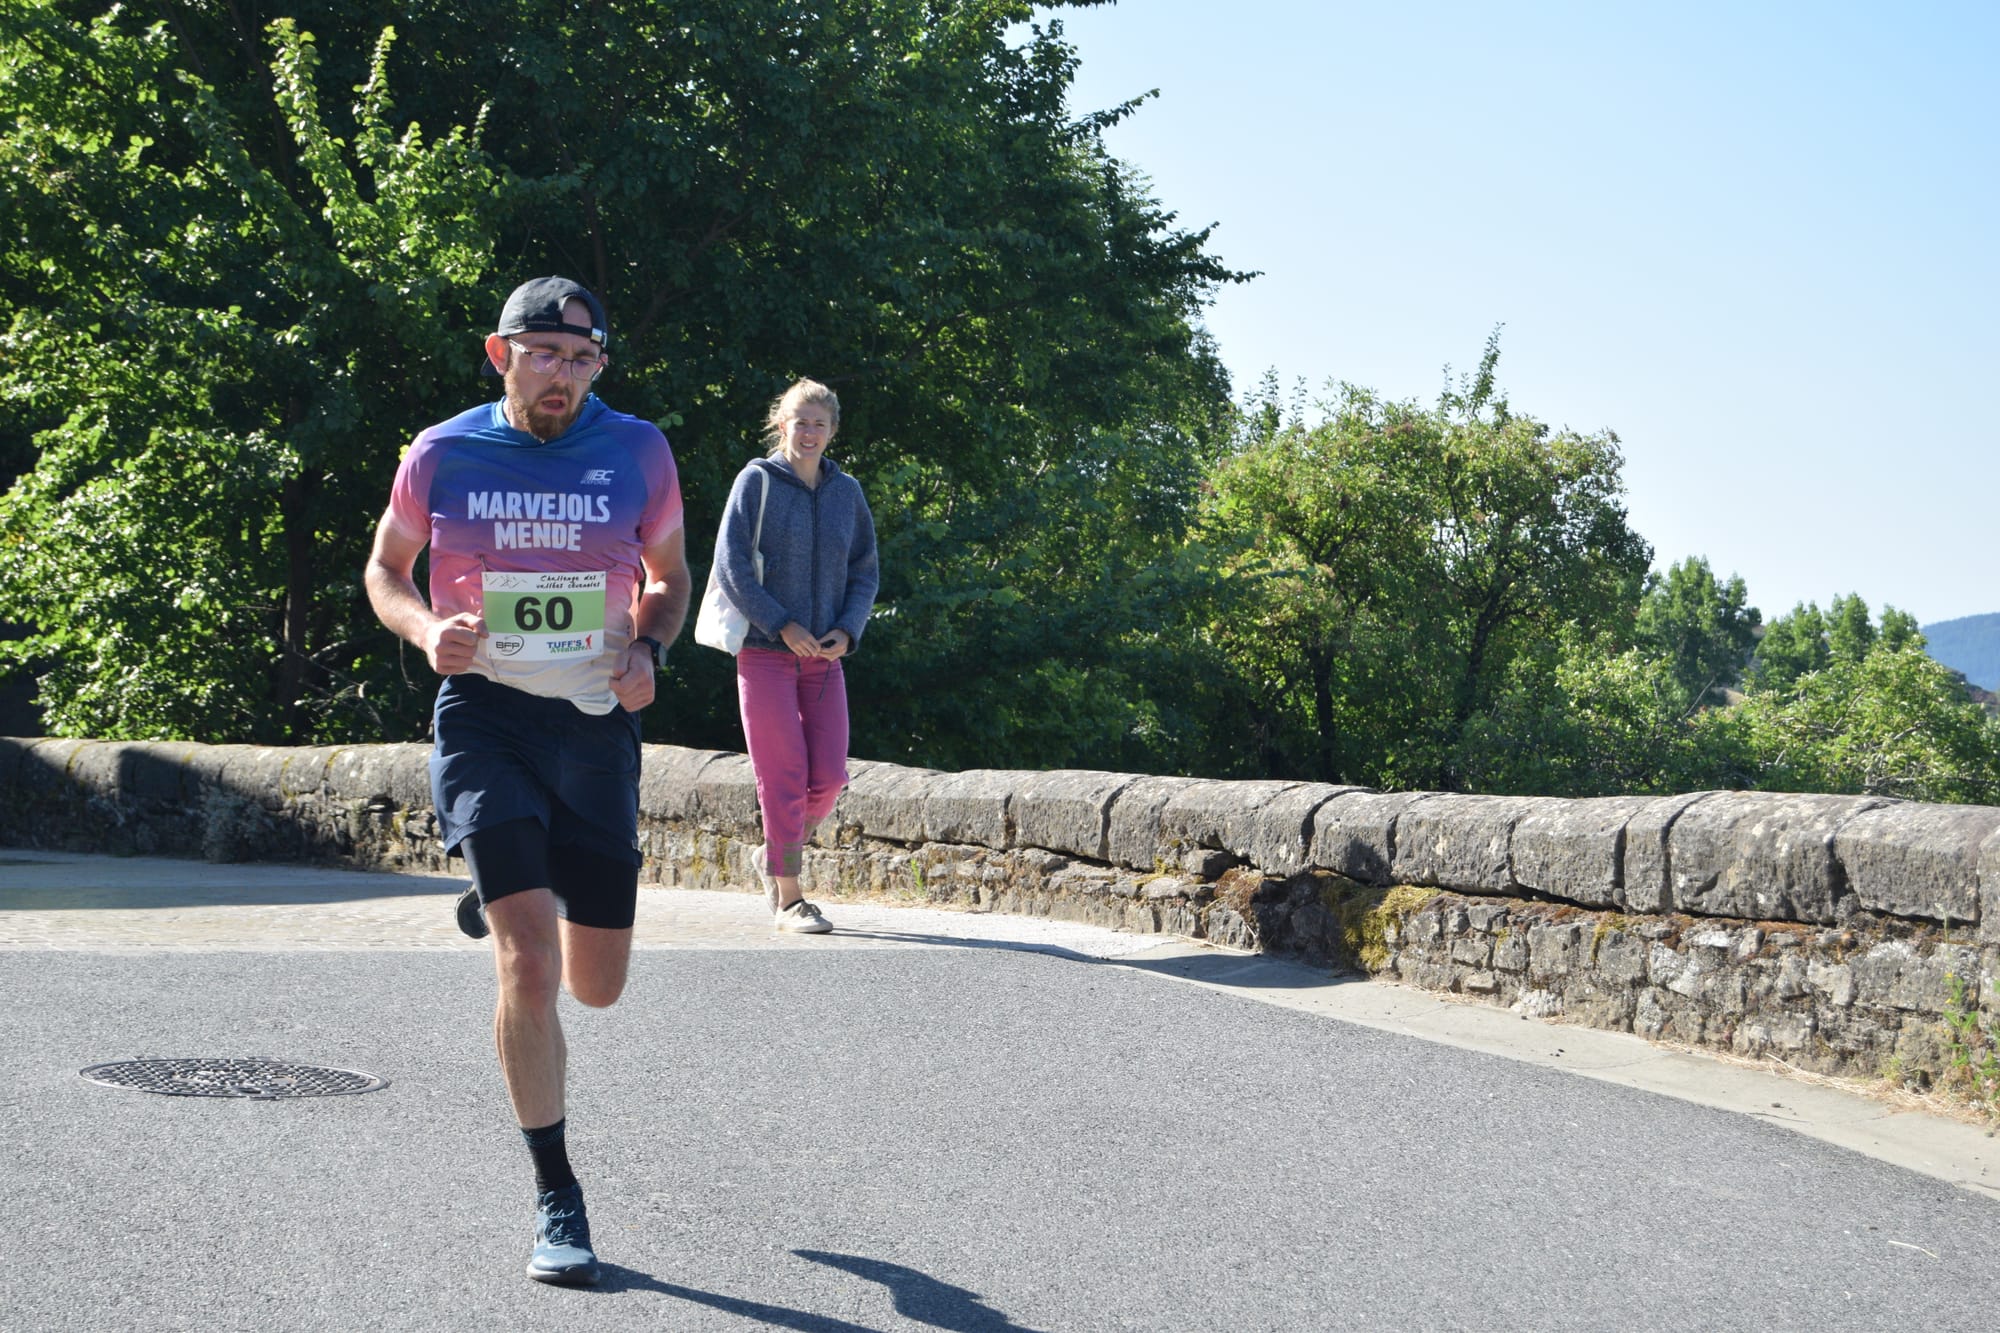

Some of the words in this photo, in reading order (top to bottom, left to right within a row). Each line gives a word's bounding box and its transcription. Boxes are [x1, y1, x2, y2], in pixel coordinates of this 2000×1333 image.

[468, 491, 611, 522] MARVEJOLS
[494, 522, 582, 551] MENDE
[540, 575, 579, 583] Challenge
[514, 596, 573, 631] 60
[546, 639, 582, 648] TUFF'S
